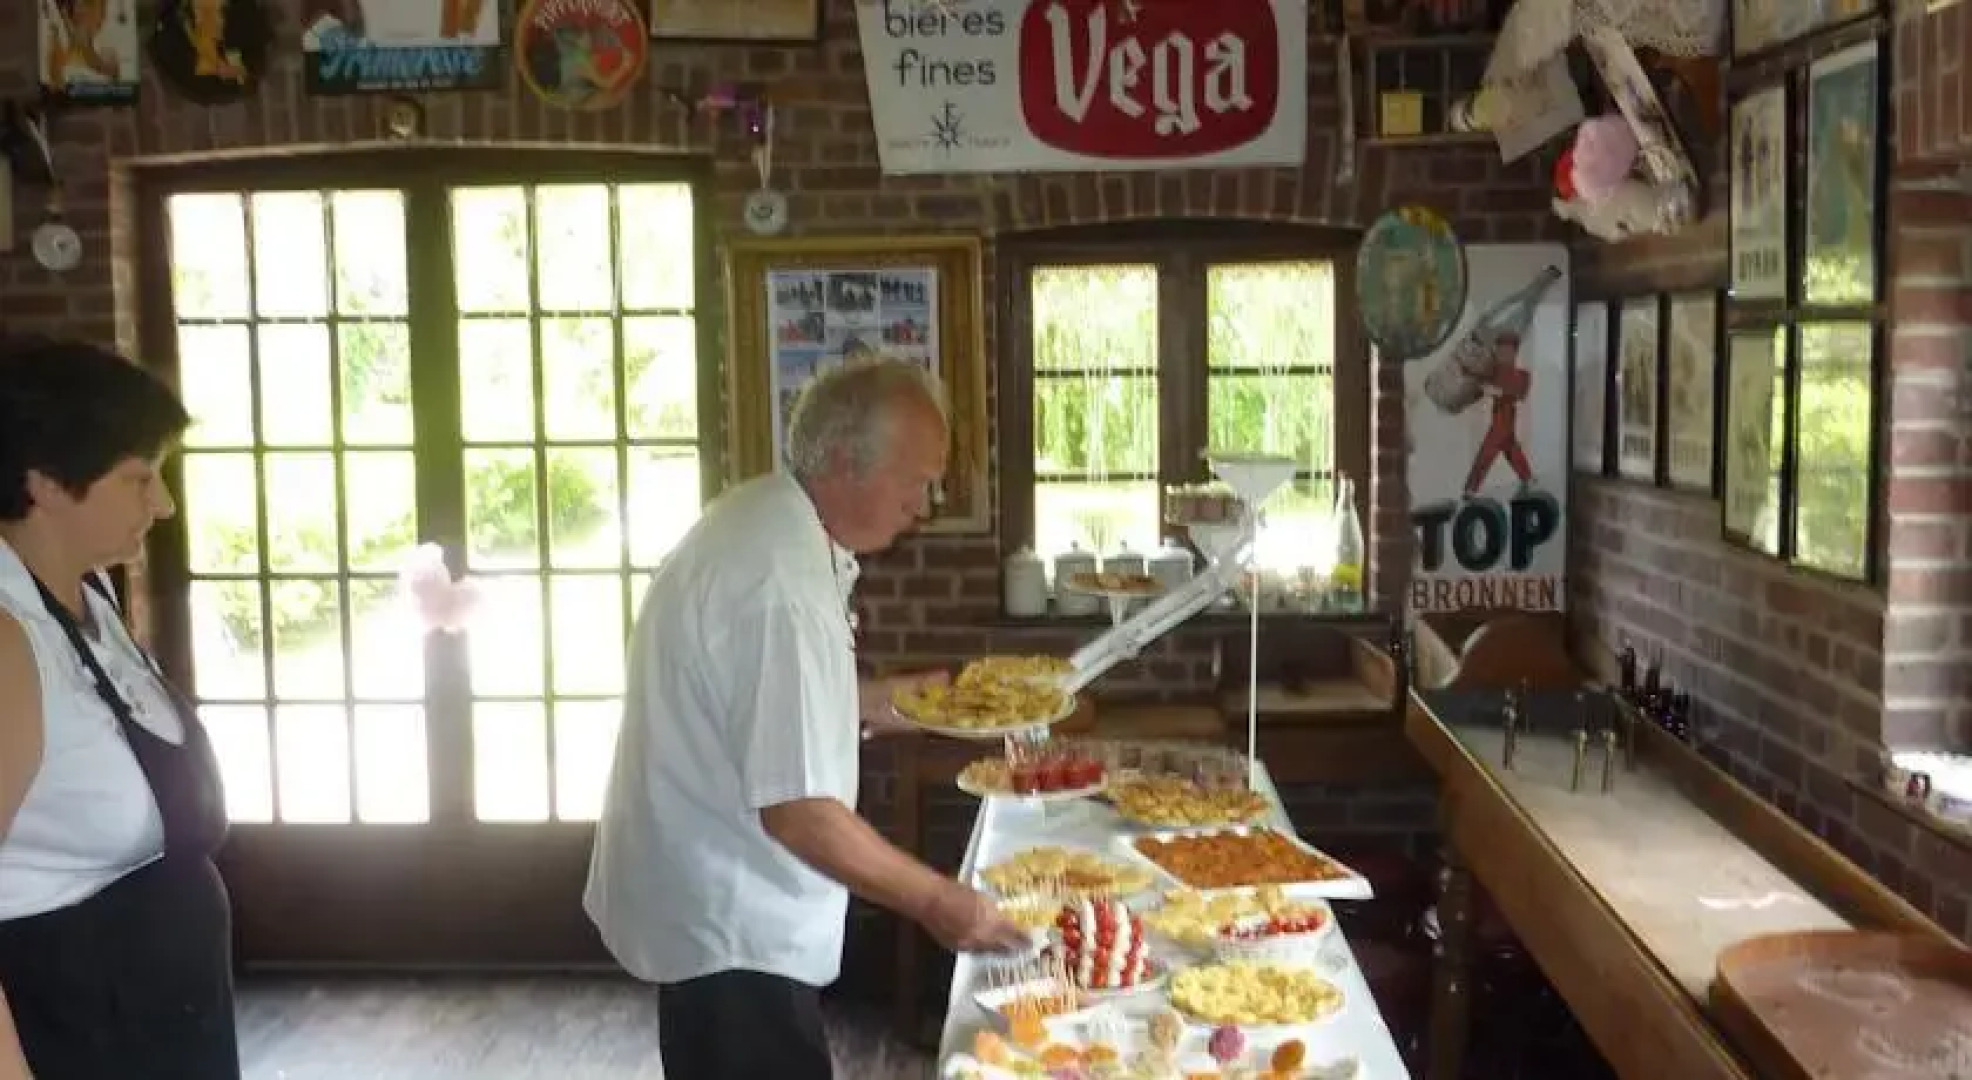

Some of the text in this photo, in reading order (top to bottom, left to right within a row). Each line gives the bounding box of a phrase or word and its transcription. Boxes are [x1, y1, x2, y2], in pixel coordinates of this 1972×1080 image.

[892, 48, 996, 87] fines
[1410, 493, 1560, 572] TOP
[1412, 576, 1556, 608] BRONNEN
